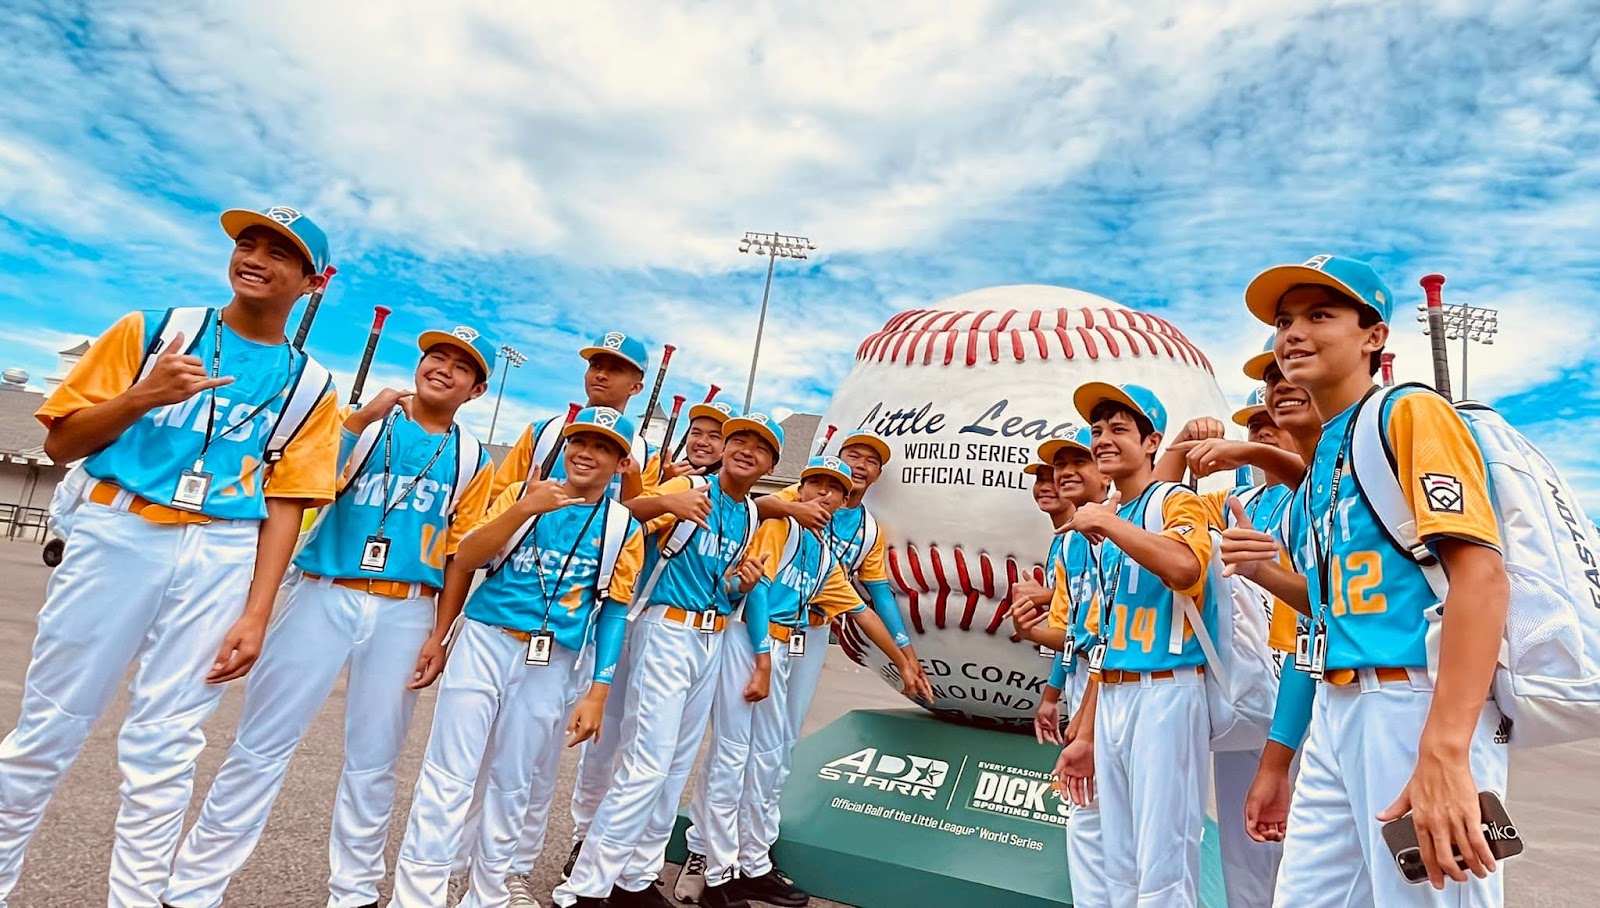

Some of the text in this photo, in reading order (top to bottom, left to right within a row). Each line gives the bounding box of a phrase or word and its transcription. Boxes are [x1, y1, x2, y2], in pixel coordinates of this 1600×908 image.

[857, 401, 946, 437] Little
[904, 443, 1030, 464] WORLD SERIES
[354, 472, 453, 517] WEST
[902, 467, 1028, 490] OFFICIAL BALL
[558, 582, 584, 617] 4
[1331, 550, 1388, 618] 12
[1110, 604, 1157, 653] 14
[961, 662, 1048, 694] CORK
[818, 767, 938, 800] STARR
[978, 761, 1060, 782] EVERY SEASON STA
[831, 797, 863, 813] Official
[864, 804, 882, 817] Ball
[882, 809, 893, 820] of
[893, 810, 911, 823] the
[912, 814, 938, 829] Little
[980, 827, 1009, 844] World
[1009, 834, 1044, 851] Series
[972, 800, 1030, 817] SPORTING
